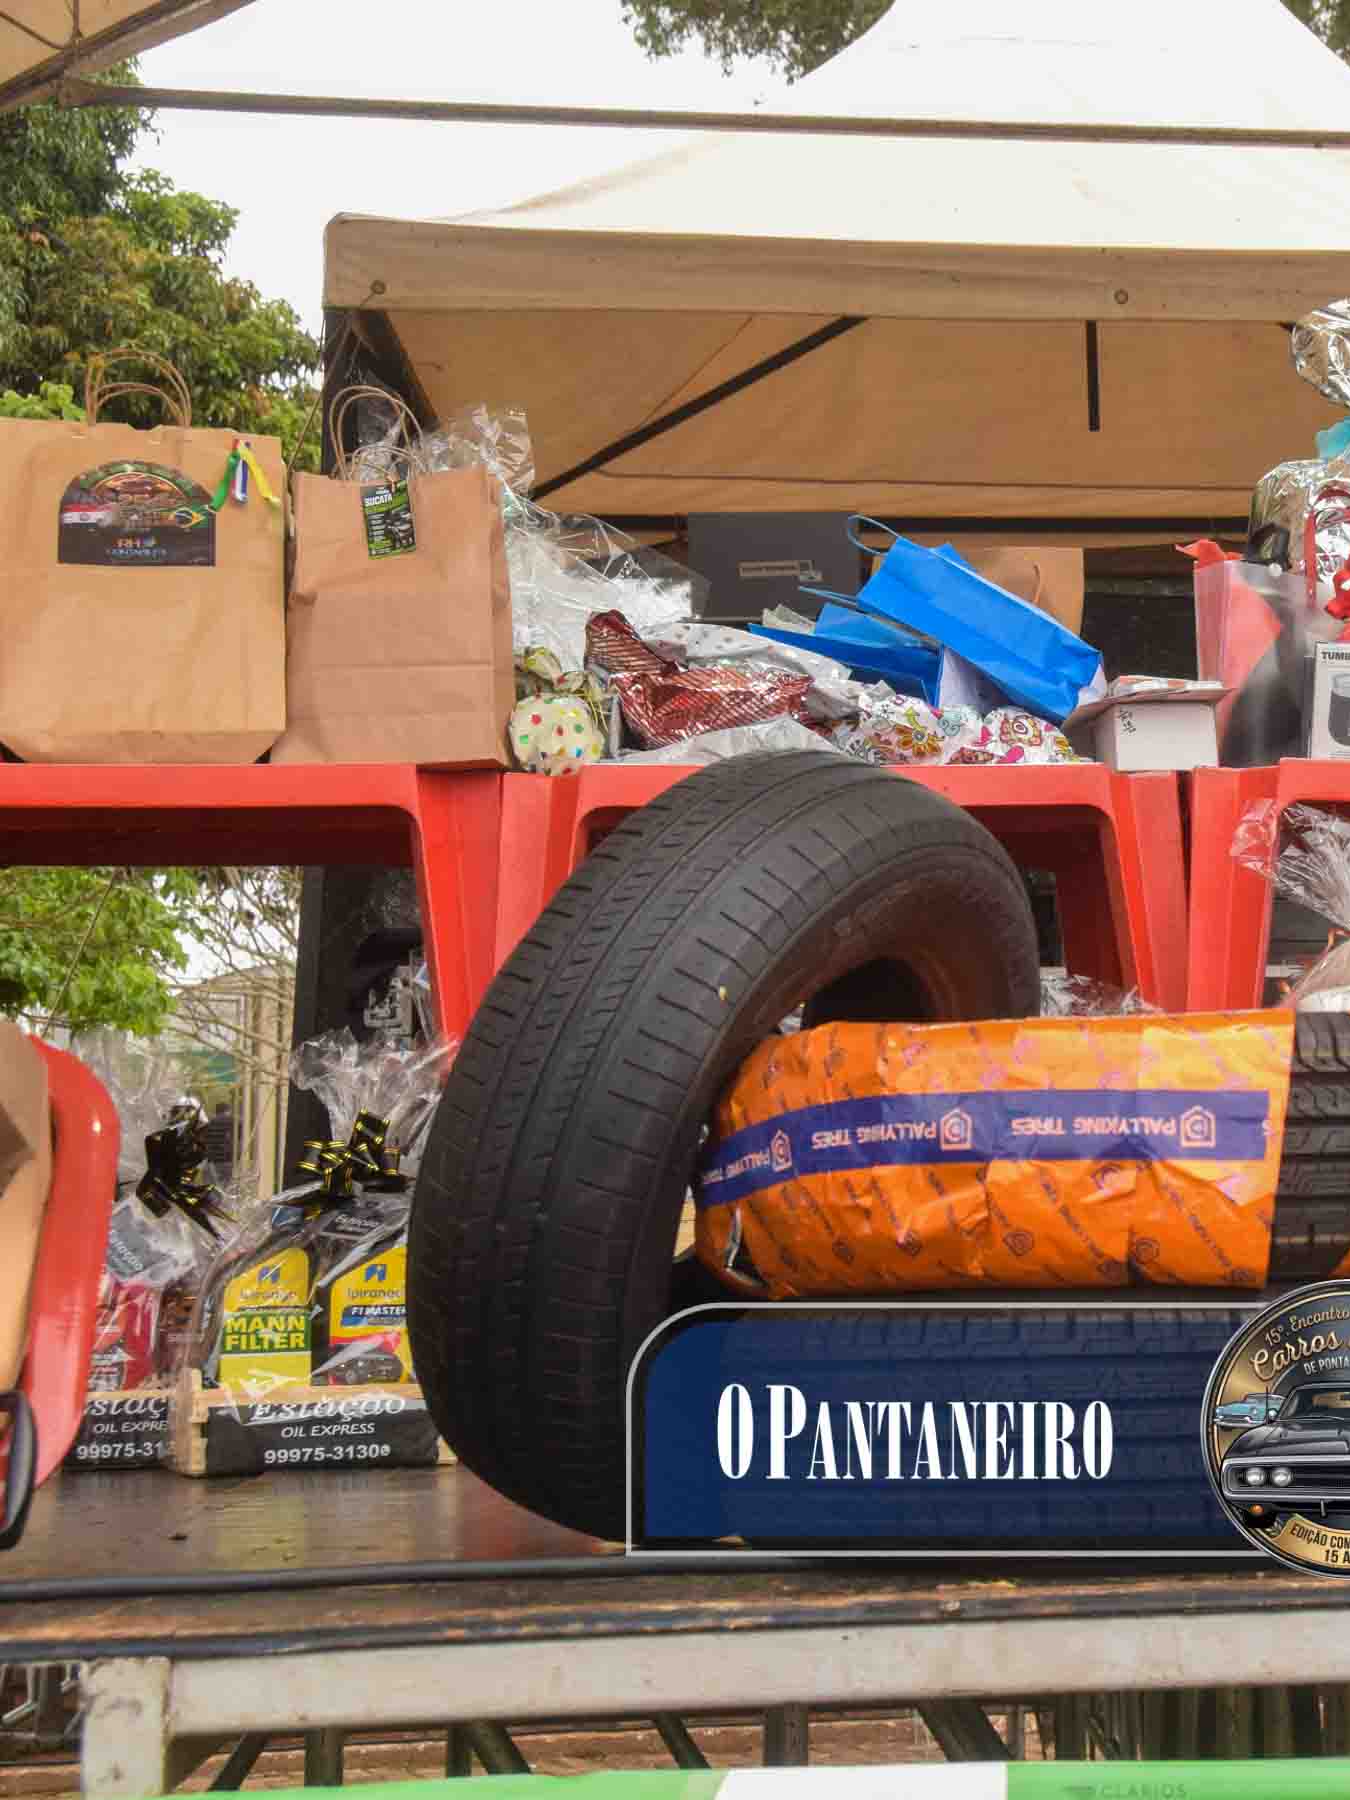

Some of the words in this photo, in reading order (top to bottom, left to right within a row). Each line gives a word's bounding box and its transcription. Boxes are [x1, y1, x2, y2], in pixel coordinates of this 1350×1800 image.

[1010, 1116, 1067, 1136] TIRES
[1071, 1115, 1177, 1136] PALLYKING
[223, 1314, 306, 1332] MANN
[224, 1332, 306, 1351] FILTER
[93, 1423, 119, 1434] OIL
[280, 1424, 306, 1438] OIL
[310, 1422, 375, 1437] EXPRESS
[1098, 1782, 1187, 1800] CLARIOS
